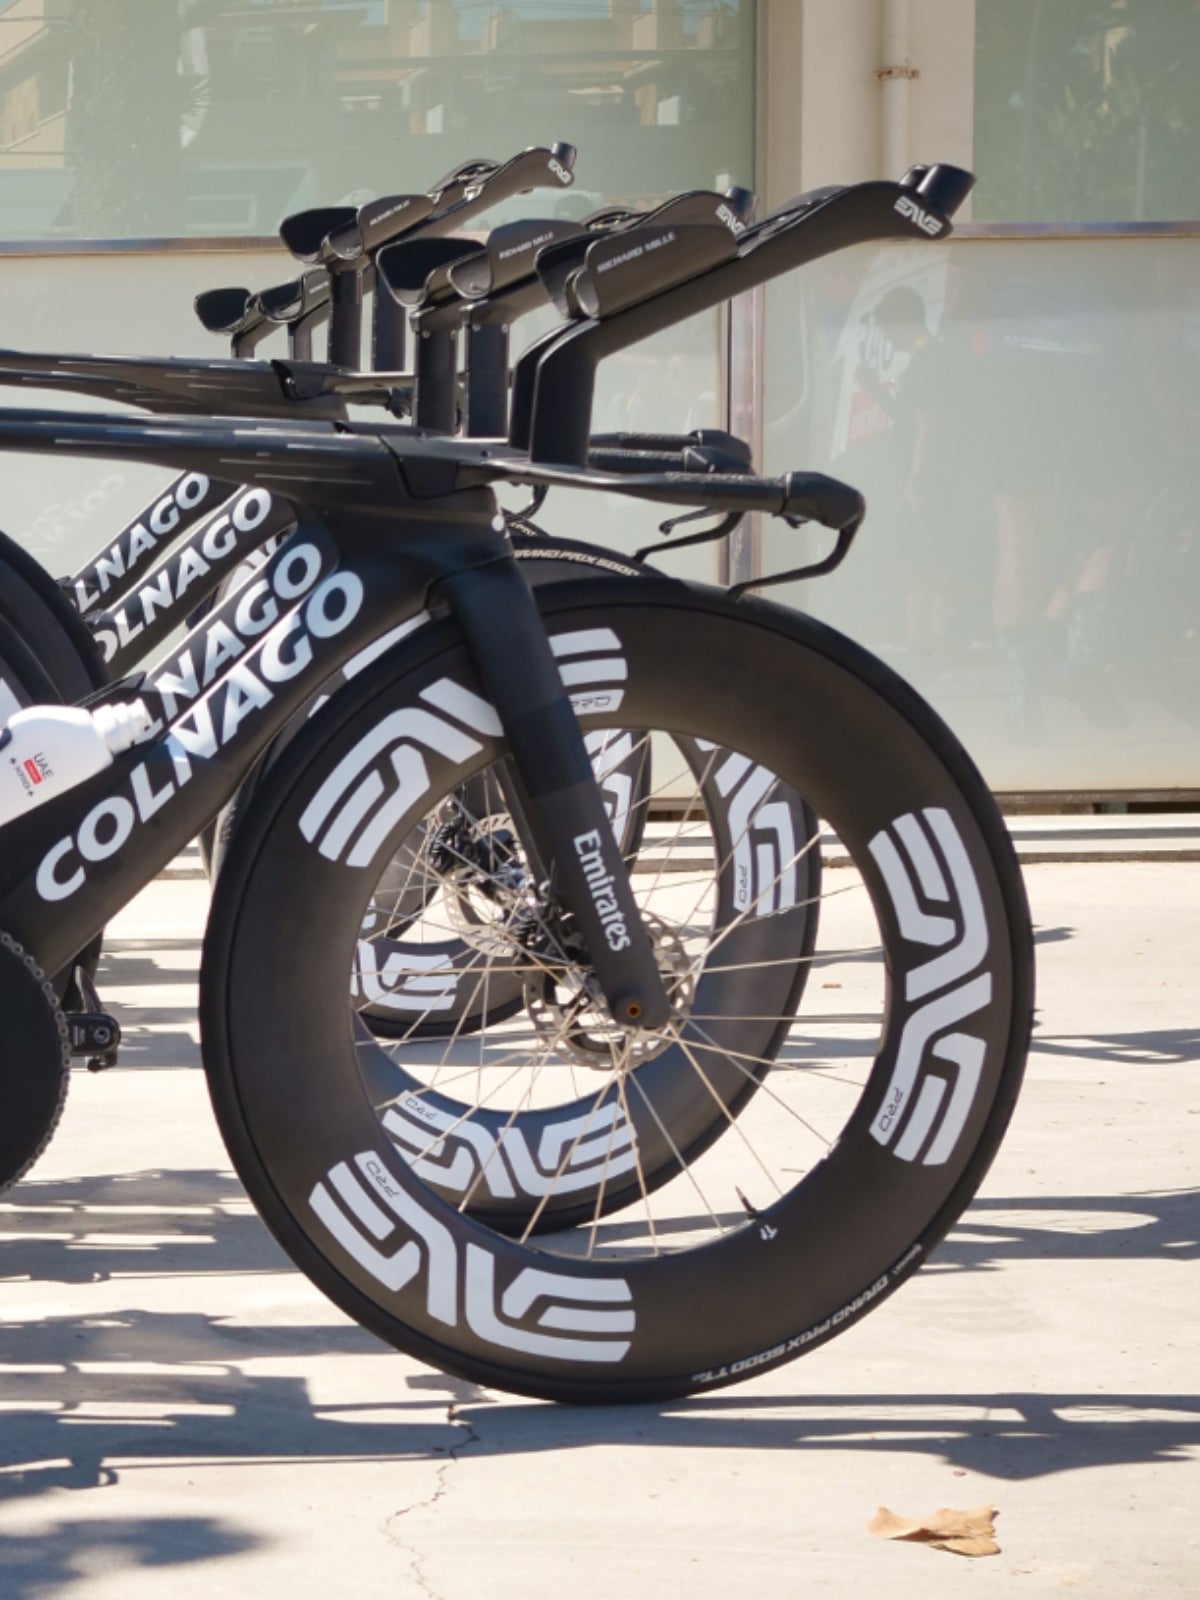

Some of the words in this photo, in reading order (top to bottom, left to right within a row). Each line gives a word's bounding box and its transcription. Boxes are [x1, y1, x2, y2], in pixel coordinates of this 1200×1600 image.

[596, 245, 644, 274] RICHARD
[644, 231, 677, 252] MILLE
[893, 195, 944, 236] ENVE
[71, 472, 210, 614] LNAGO
[92, 487, 272, 664] OLNAGO
[147, 543, 323, 739] NAGO
[33, 752, 54, 780] UAE
[35, 570, 364, 901] COLNAGO
[573, 830, 631, 953] Emirates
[868, 806, 992, 1166] ENVE
[878, 1086, 903, 1132] PRO
[308, 1149, 636, 1363] ENVE
[831, 1273, 890, 1326] GRAND
[729, 1343, 786, 1375] 5000
[787, 1318, 831, 1352] PRIX
